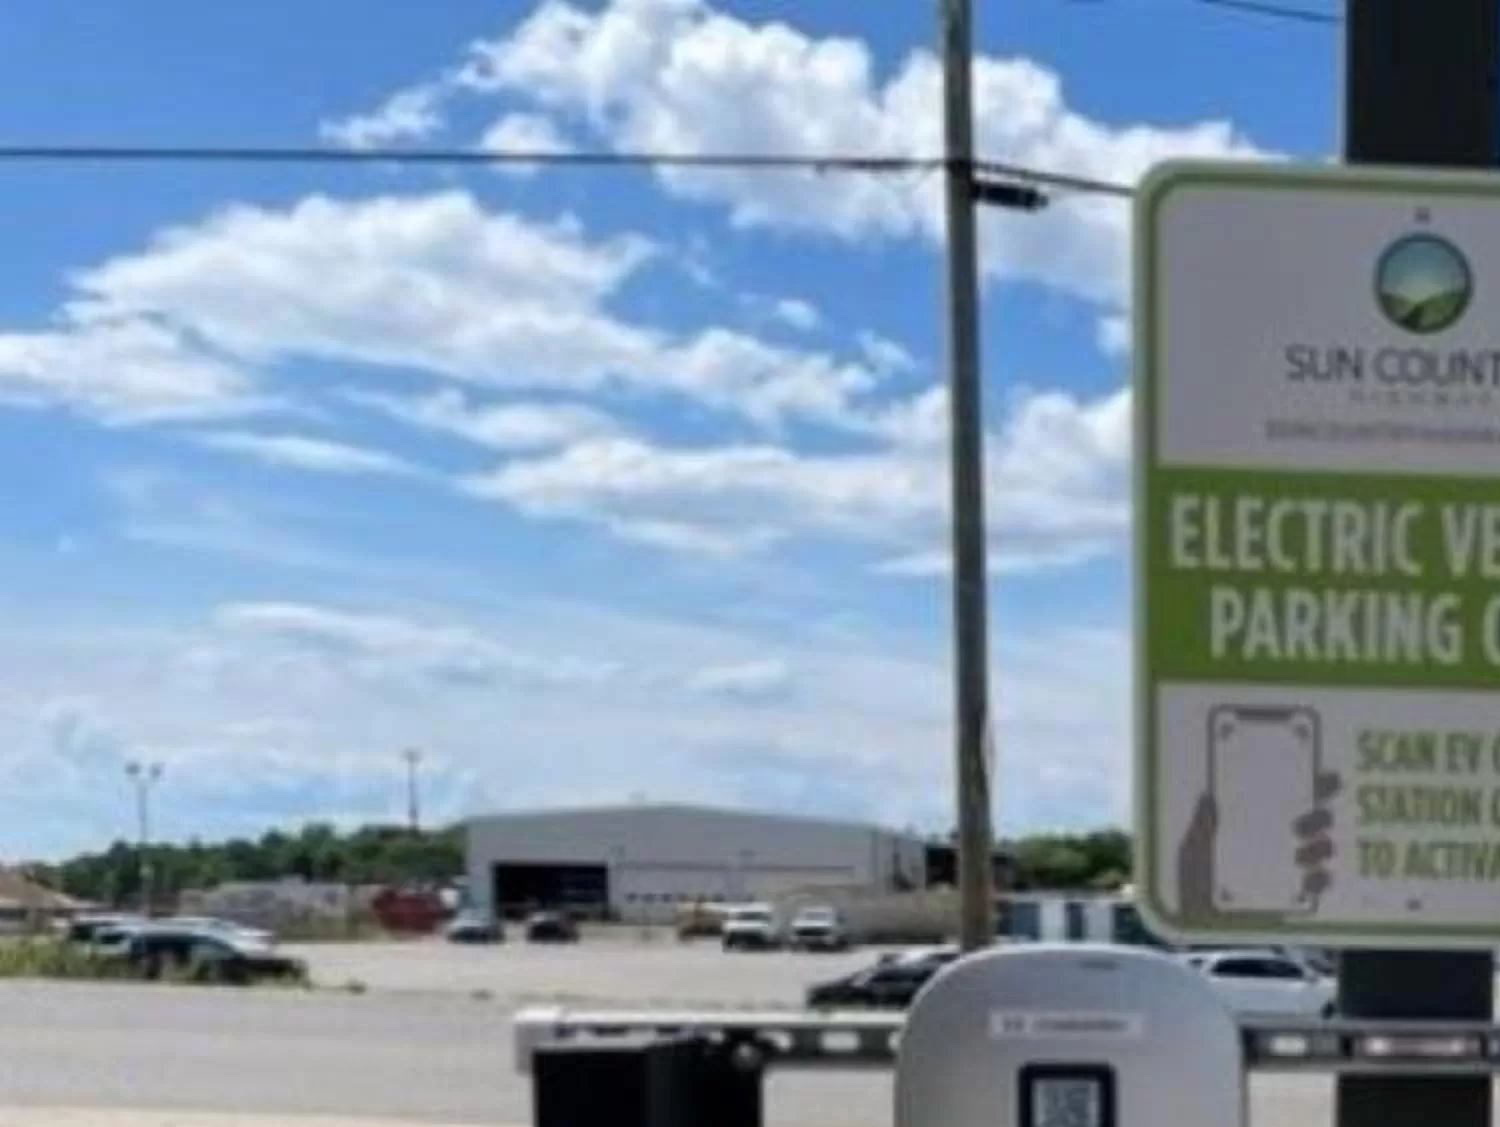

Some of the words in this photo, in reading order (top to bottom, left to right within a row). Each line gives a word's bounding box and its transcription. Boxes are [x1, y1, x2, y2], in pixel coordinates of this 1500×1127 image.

[1285, 345, 1364, 383] SUN
[1169, 493, 1424, 577] ELECTRIC
[1208, 587, 1464, 665] PARKING
[1356, 729, 1437, 773] SCAN
[1446, 732, 1483, 775] EV
[1356, 783, 1482, 827] STATION
[1356, 838, 1396, 880] TO
